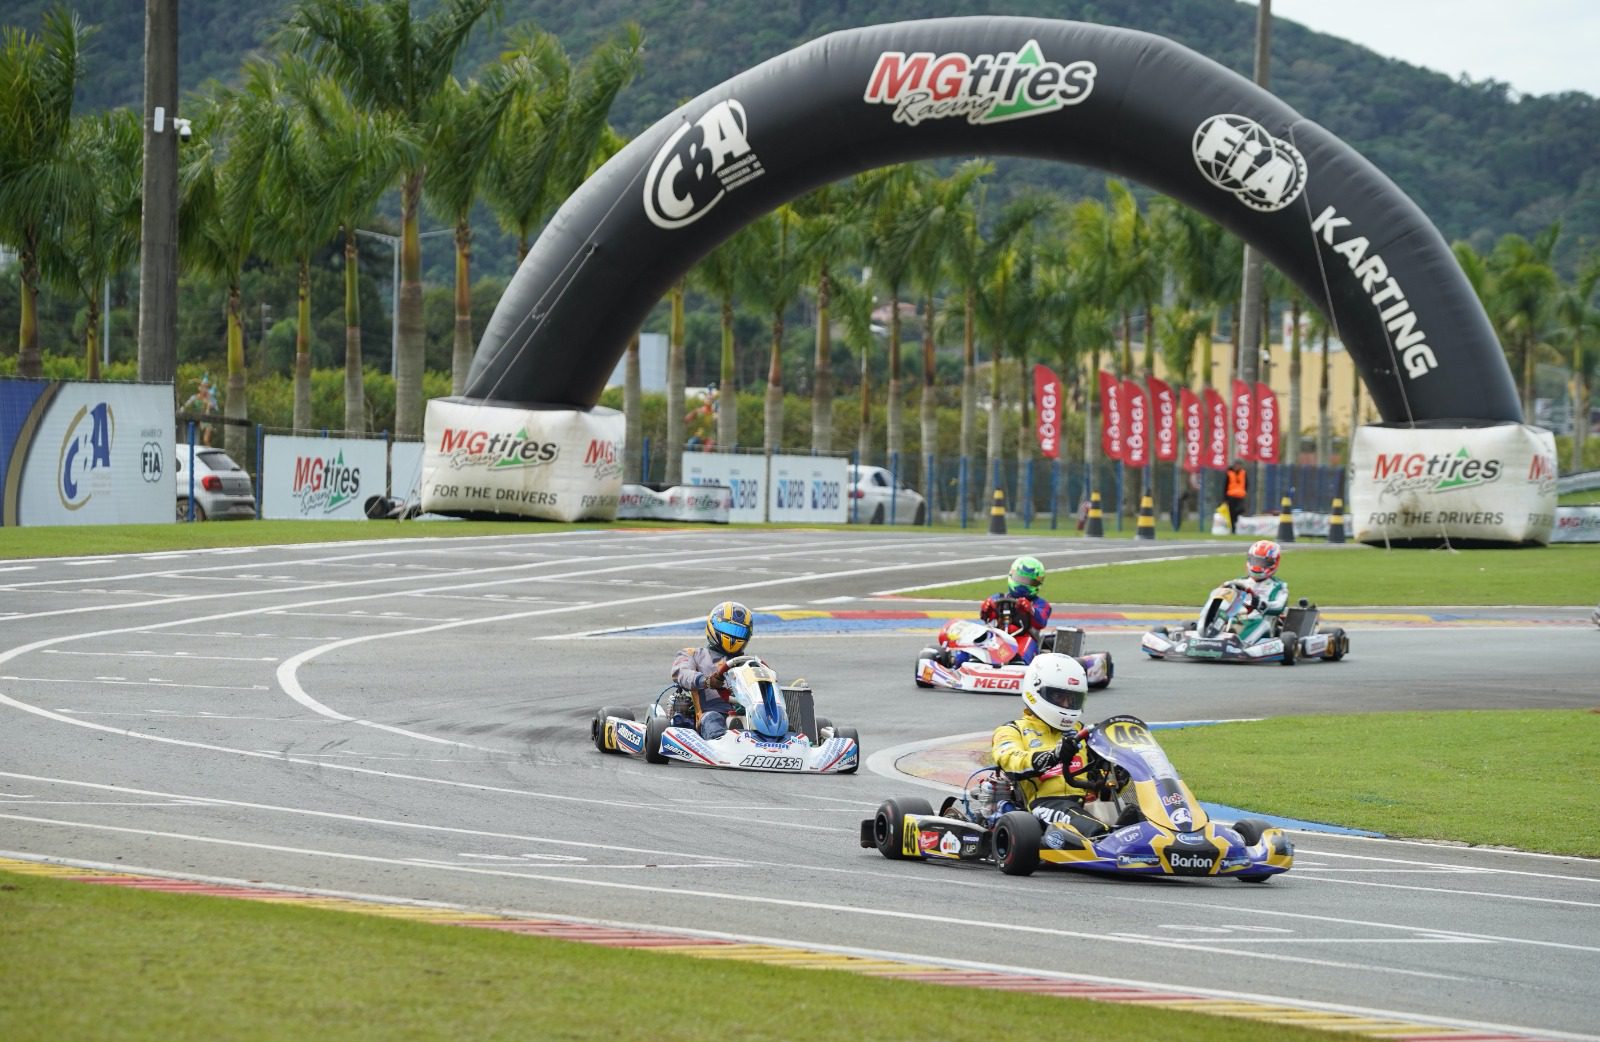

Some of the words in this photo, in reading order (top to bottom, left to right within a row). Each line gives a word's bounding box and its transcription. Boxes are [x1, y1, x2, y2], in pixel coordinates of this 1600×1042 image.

[868, 54, 1092, 104] MGtires
[897, 91, 996, 122] Racing
[1311, 205, 1438, 379] KARTING
[440, 429, 558, 462] MGtires
[293, 455, 360, 494] MGtires
[1372, 453, 1501, 481] MGtires
[433, 484, 459, 498] FOR
[465, 486, 491, 499] THE
[496, 488, 557, 506] DRIVERS
[1368, 512, 1397, 525] FOR
[1403, 511, 1432, 525] THE
[1437, 511, 1504, 525] DRIVERS
[973, 677, 1021, 690] MEGA
[1113, 724, 1157, 747] 46
[904, 822, 917, 855] 46
[1170, 852, 1213, 869] Barion
